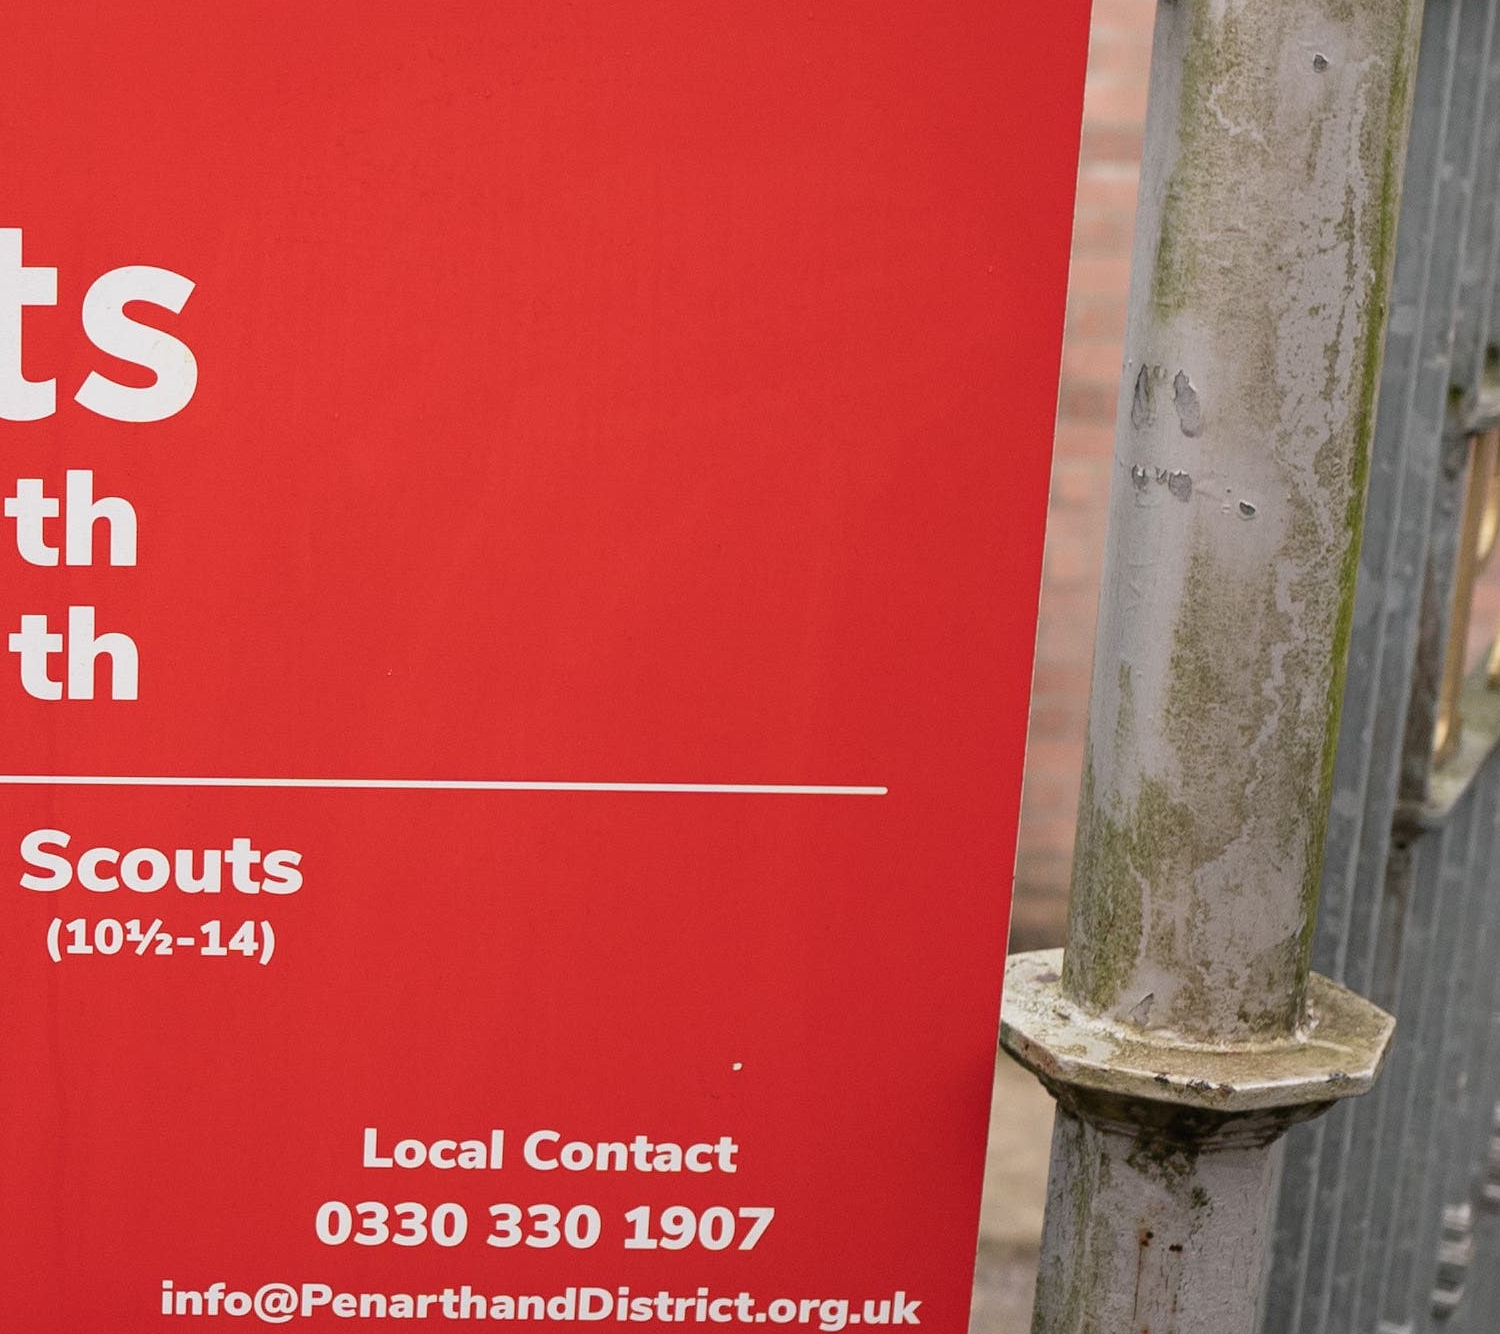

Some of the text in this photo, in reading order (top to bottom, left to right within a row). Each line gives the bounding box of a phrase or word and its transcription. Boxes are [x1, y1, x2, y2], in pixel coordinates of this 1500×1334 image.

[18, 827, 304, 896] Scouts
[45, 916, 276, 966] (10½-14)
[362, 1126, 740, 1174] Local Contact
[314, 1199, 776, 1252] 0330 330 1907
[160, 1278, 922, 1333] info@PenarthandDistrict.org.uk
